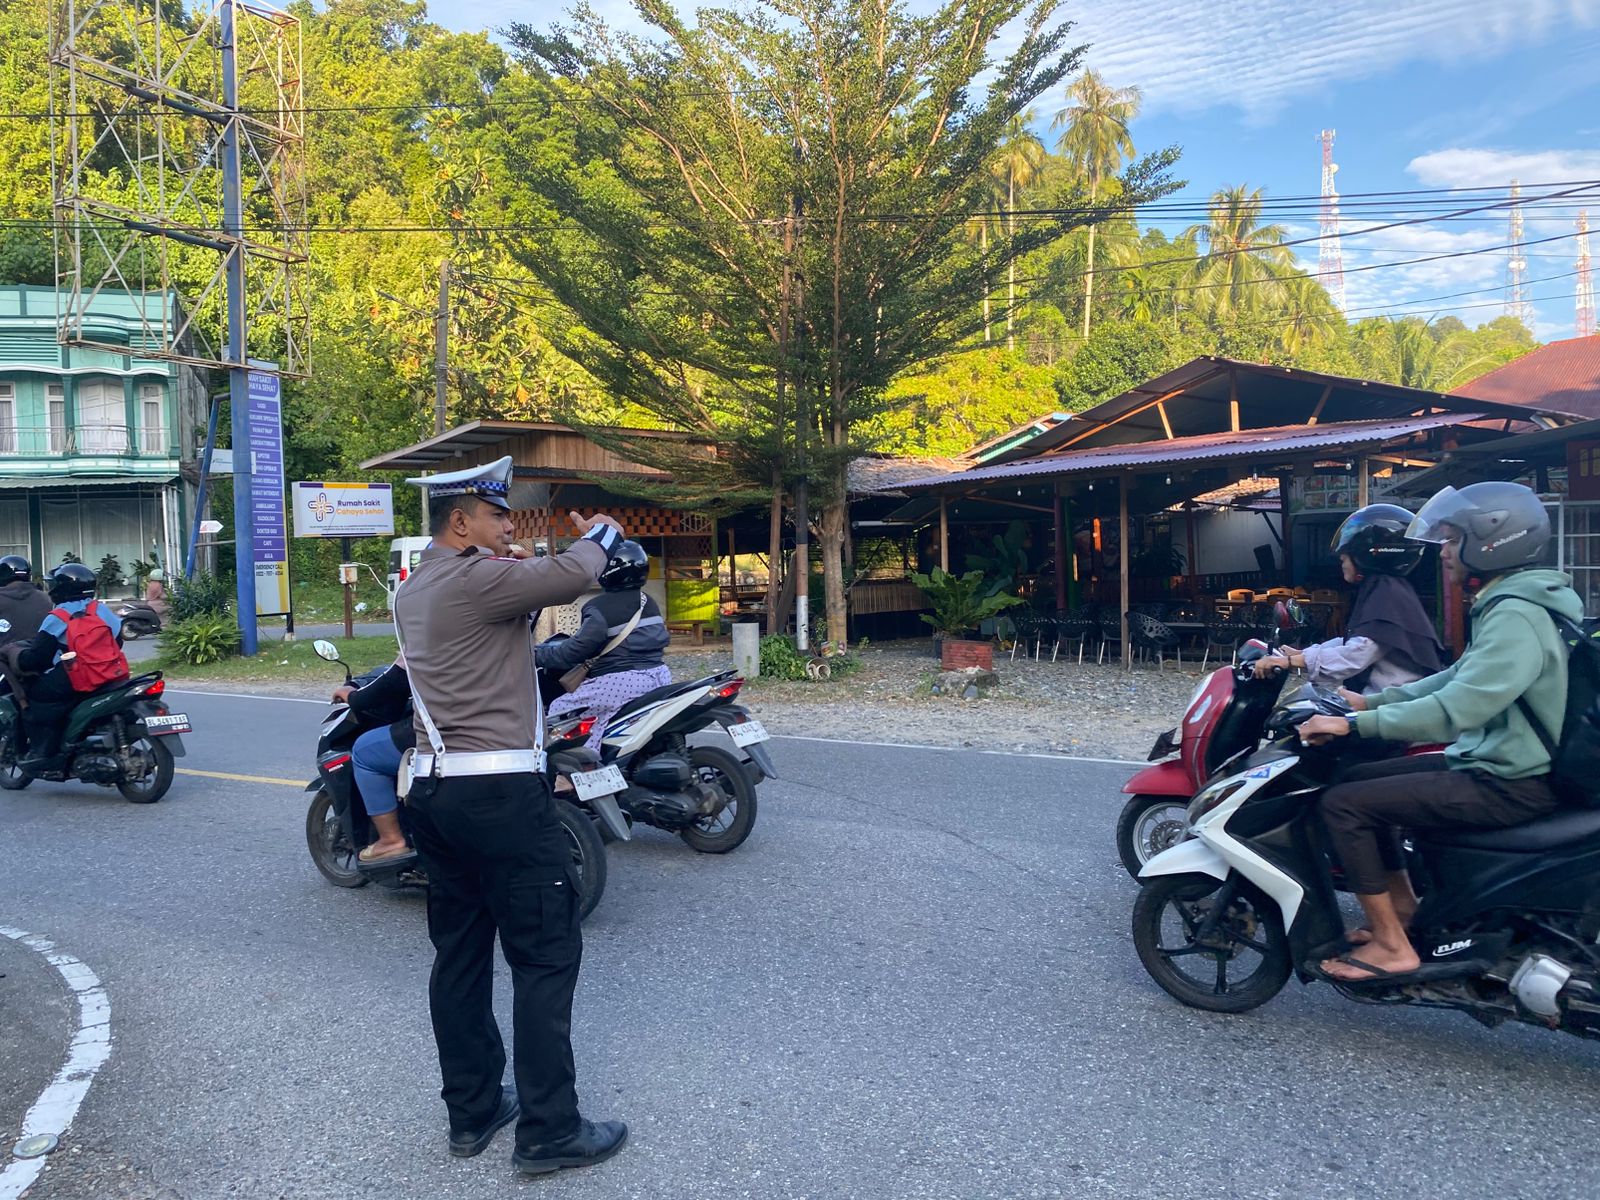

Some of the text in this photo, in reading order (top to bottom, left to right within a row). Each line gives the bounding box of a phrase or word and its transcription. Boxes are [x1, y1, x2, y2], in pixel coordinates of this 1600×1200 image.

[262, 384, 276, 393] SEHAT
[336, 508, 364, 516] Cahaya
[574, 775, 586, 787] BL
[608, 766, 620, 778] TU
[1437, 939, 1472, 953] DJM
